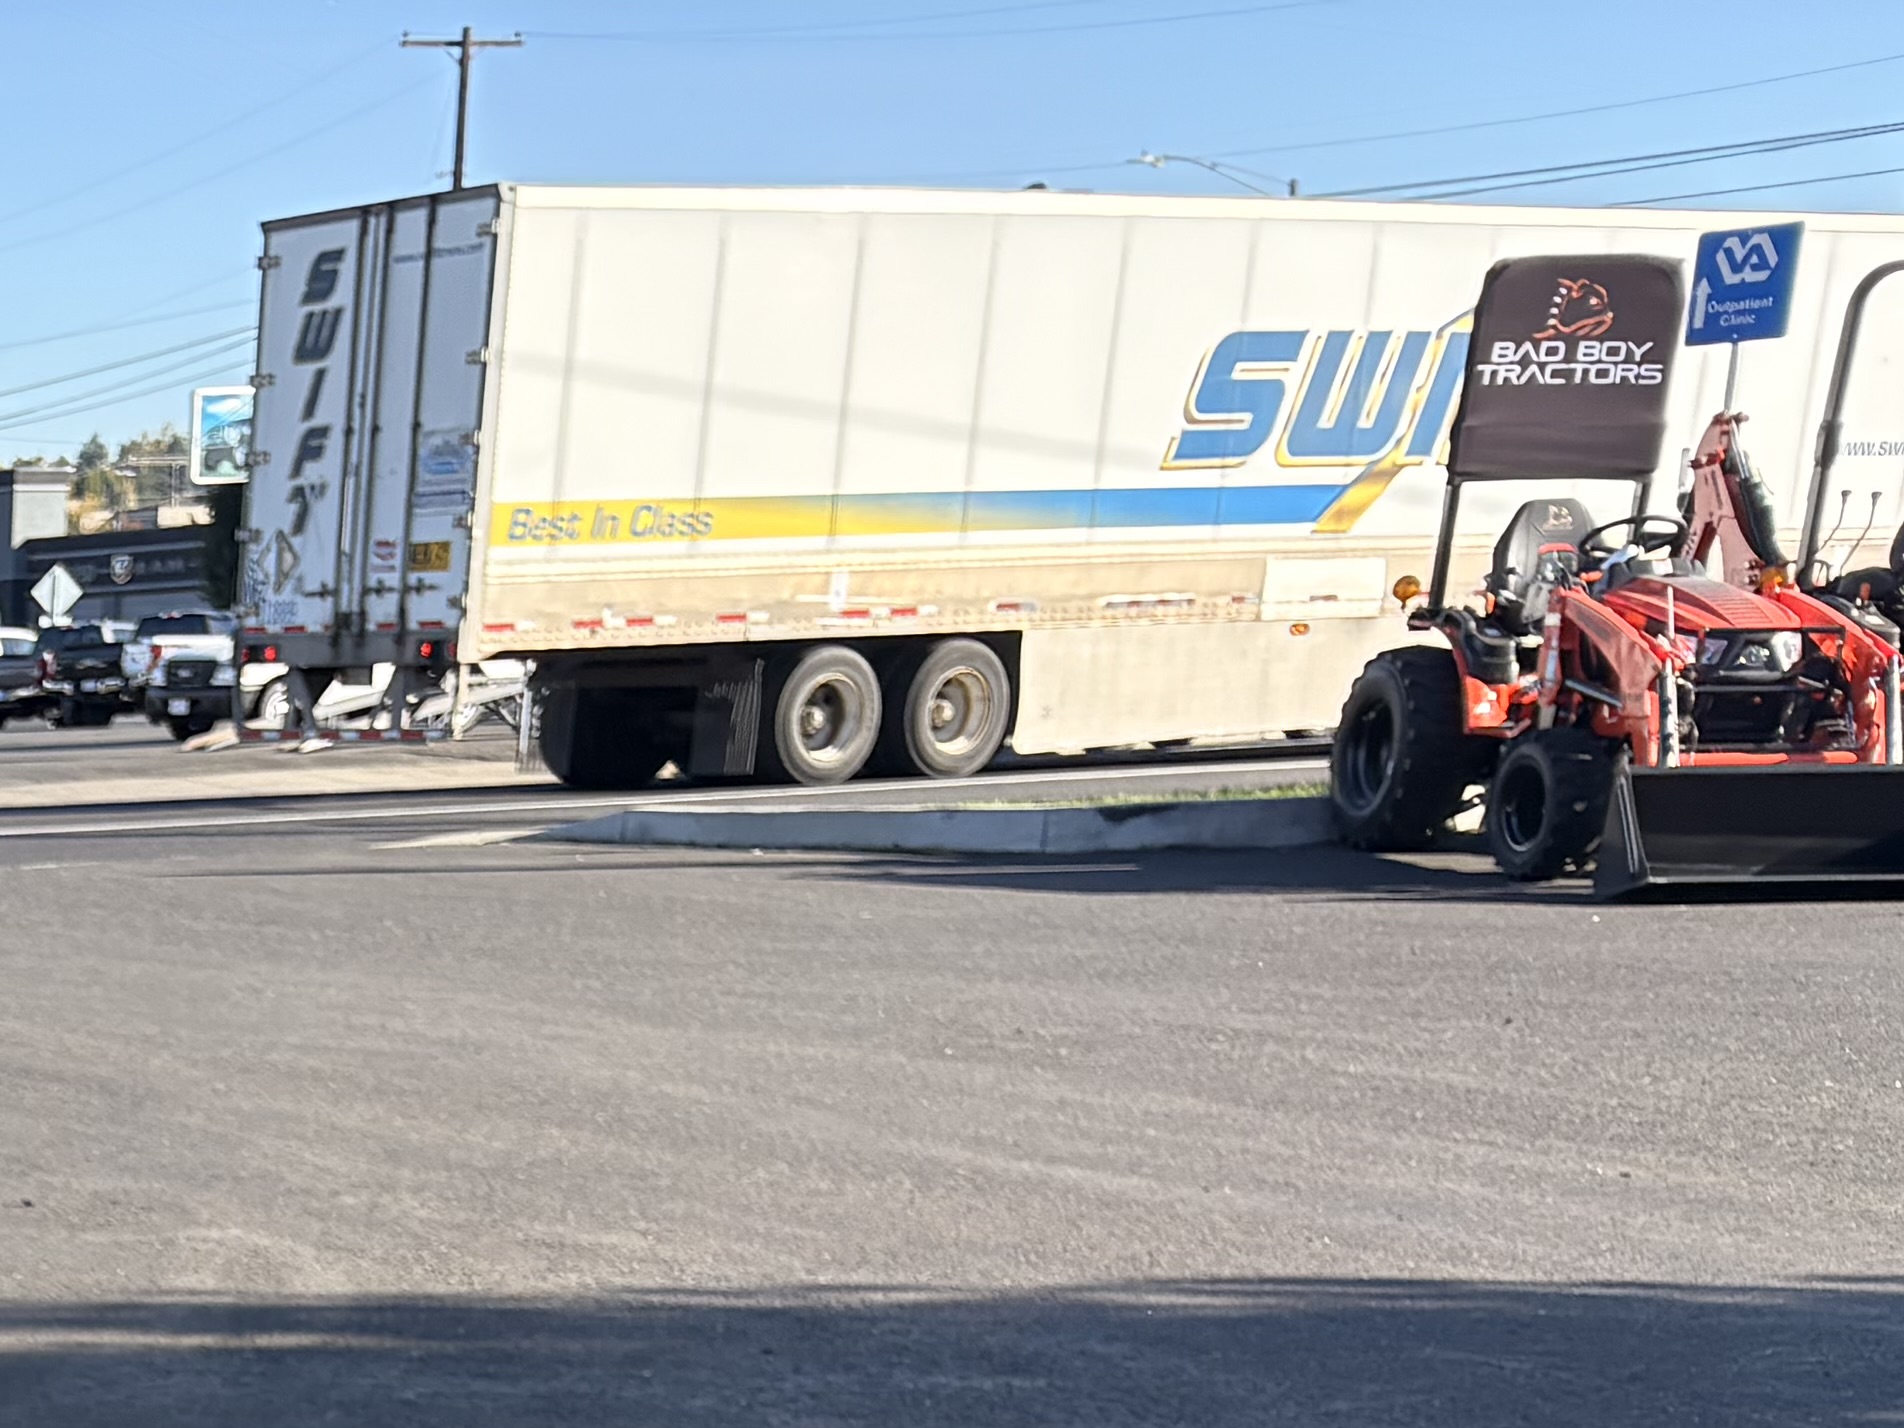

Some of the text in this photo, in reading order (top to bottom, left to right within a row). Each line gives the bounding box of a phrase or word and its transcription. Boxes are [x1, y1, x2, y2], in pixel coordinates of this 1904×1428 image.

[1708, 297, 1773, 313] Outpatient
[1720, 315, 1756, 327] Clinic
[1490, 340, 1654, 363] BAD BOY
[1476, 363, 1664, 386] TRACTORS
[287, 247, 346, 537] SWIFT
[1160, 329, 1472, 470] SWI
[508, 504, 714, 541] Best In Class
